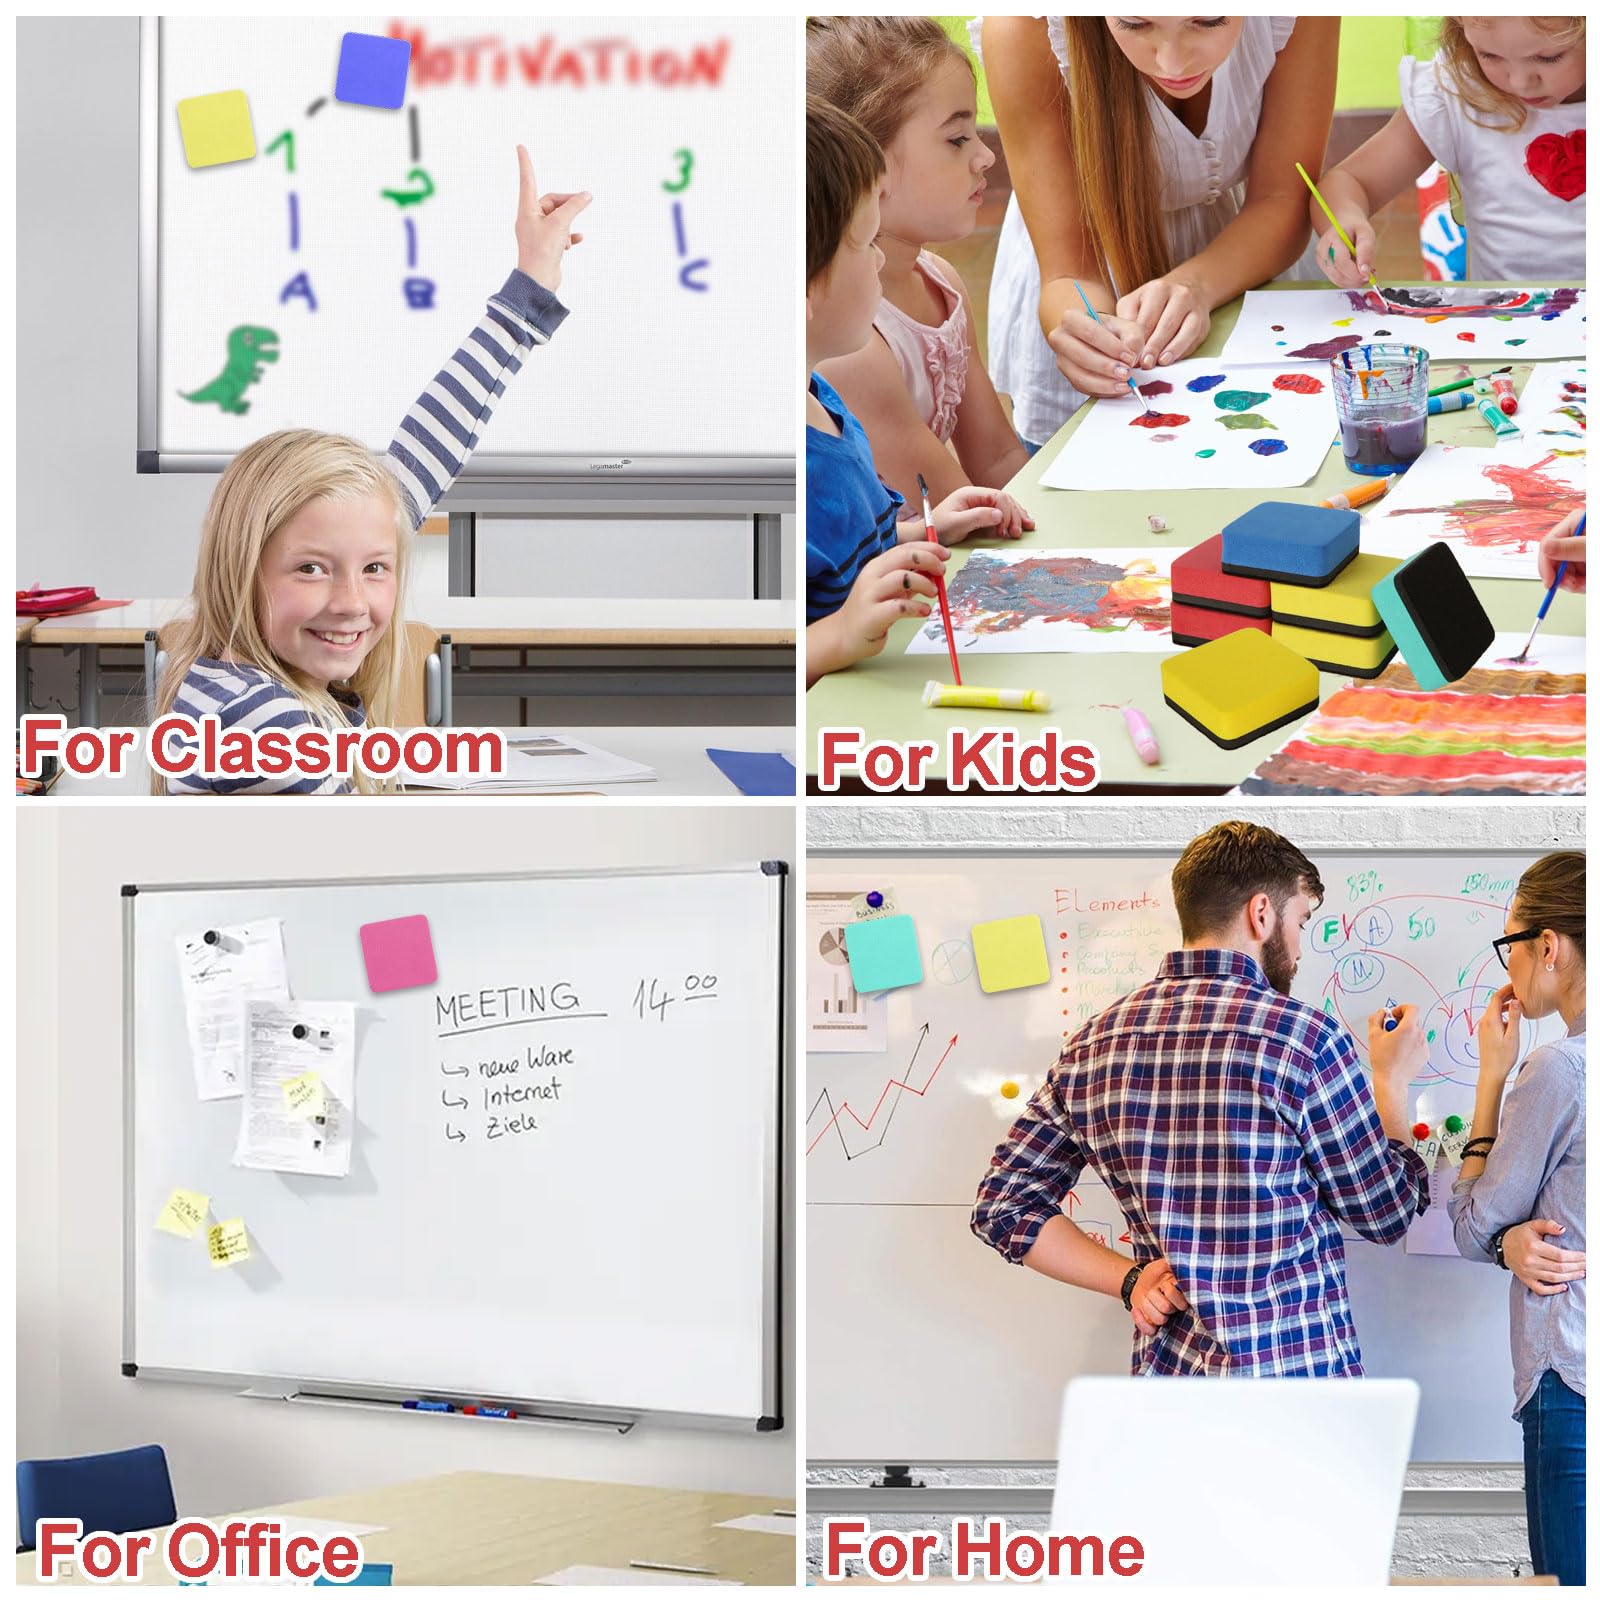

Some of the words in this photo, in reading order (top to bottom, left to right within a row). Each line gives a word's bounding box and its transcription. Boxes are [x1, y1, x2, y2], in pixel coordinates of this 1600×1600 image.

[265, 130, 295, 173] 1
[661, 147, 695, 193] 3
[279, 270, 318, 313] A
[678, 258, 710, 292] C
[402, 276, 436, 310] B
[1323, 920, 1339, 943] F
[435, 982, 580, 1028] MEETING
[527, 1045, 575, 1070] Ware
[484, 1076, 562, 1110] Internet
[486, 1113, 539, 1140] Ziele
